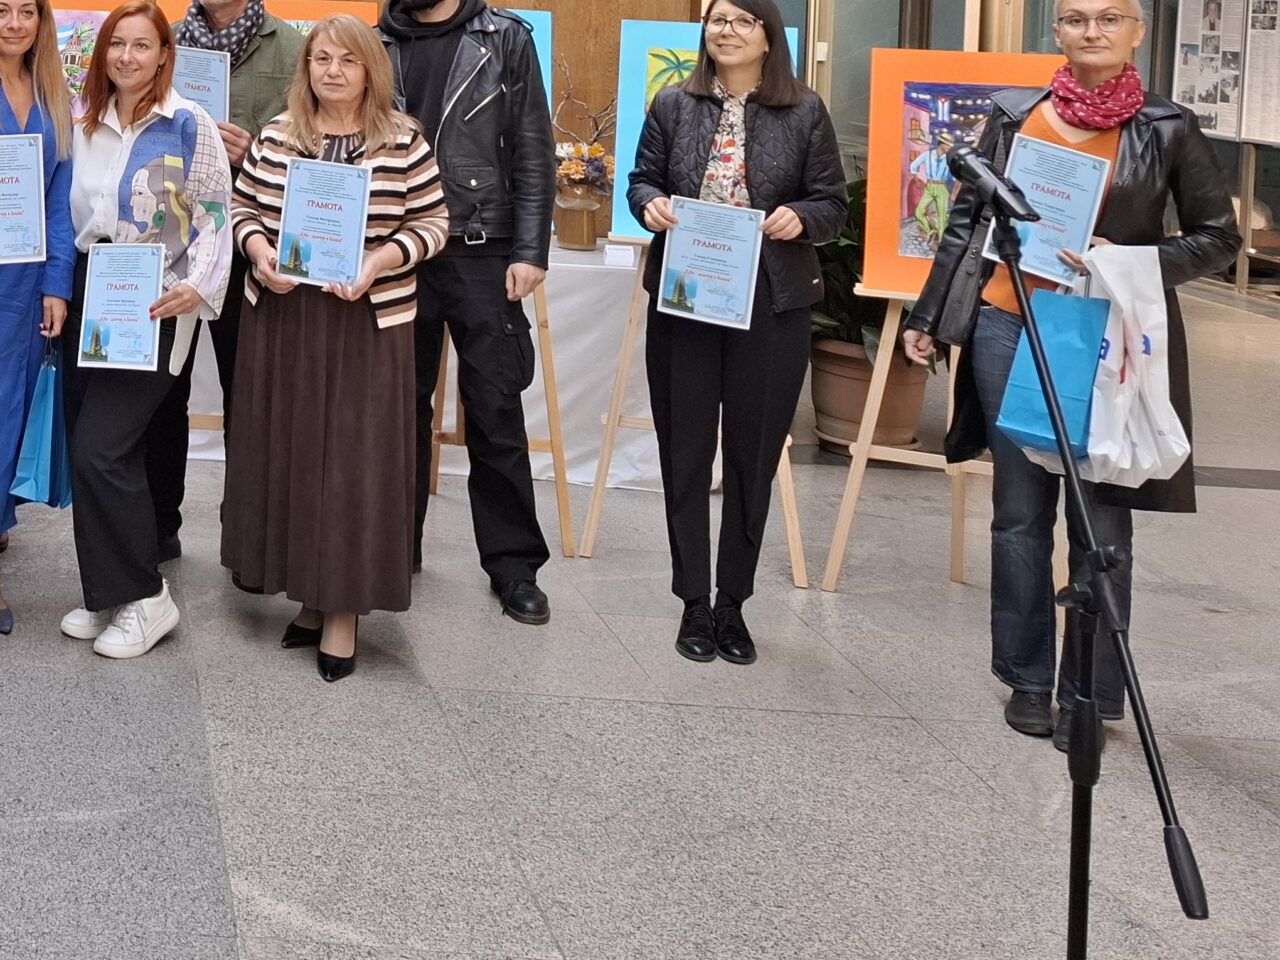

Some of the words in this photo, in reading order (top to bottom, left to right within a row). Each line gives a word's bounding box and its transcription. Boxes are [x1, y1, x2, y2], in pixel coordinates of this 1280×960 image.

[184, 82, 211, 93] ГРАМОТА
[1030, 182, 1072, 201] ГРАМОТА
[307, 199, 343, 212] ГРАМОТА
[692, 238, 733, 253] ГРАМОТА
[106, 283, 139, 292] ГРАМОТА
